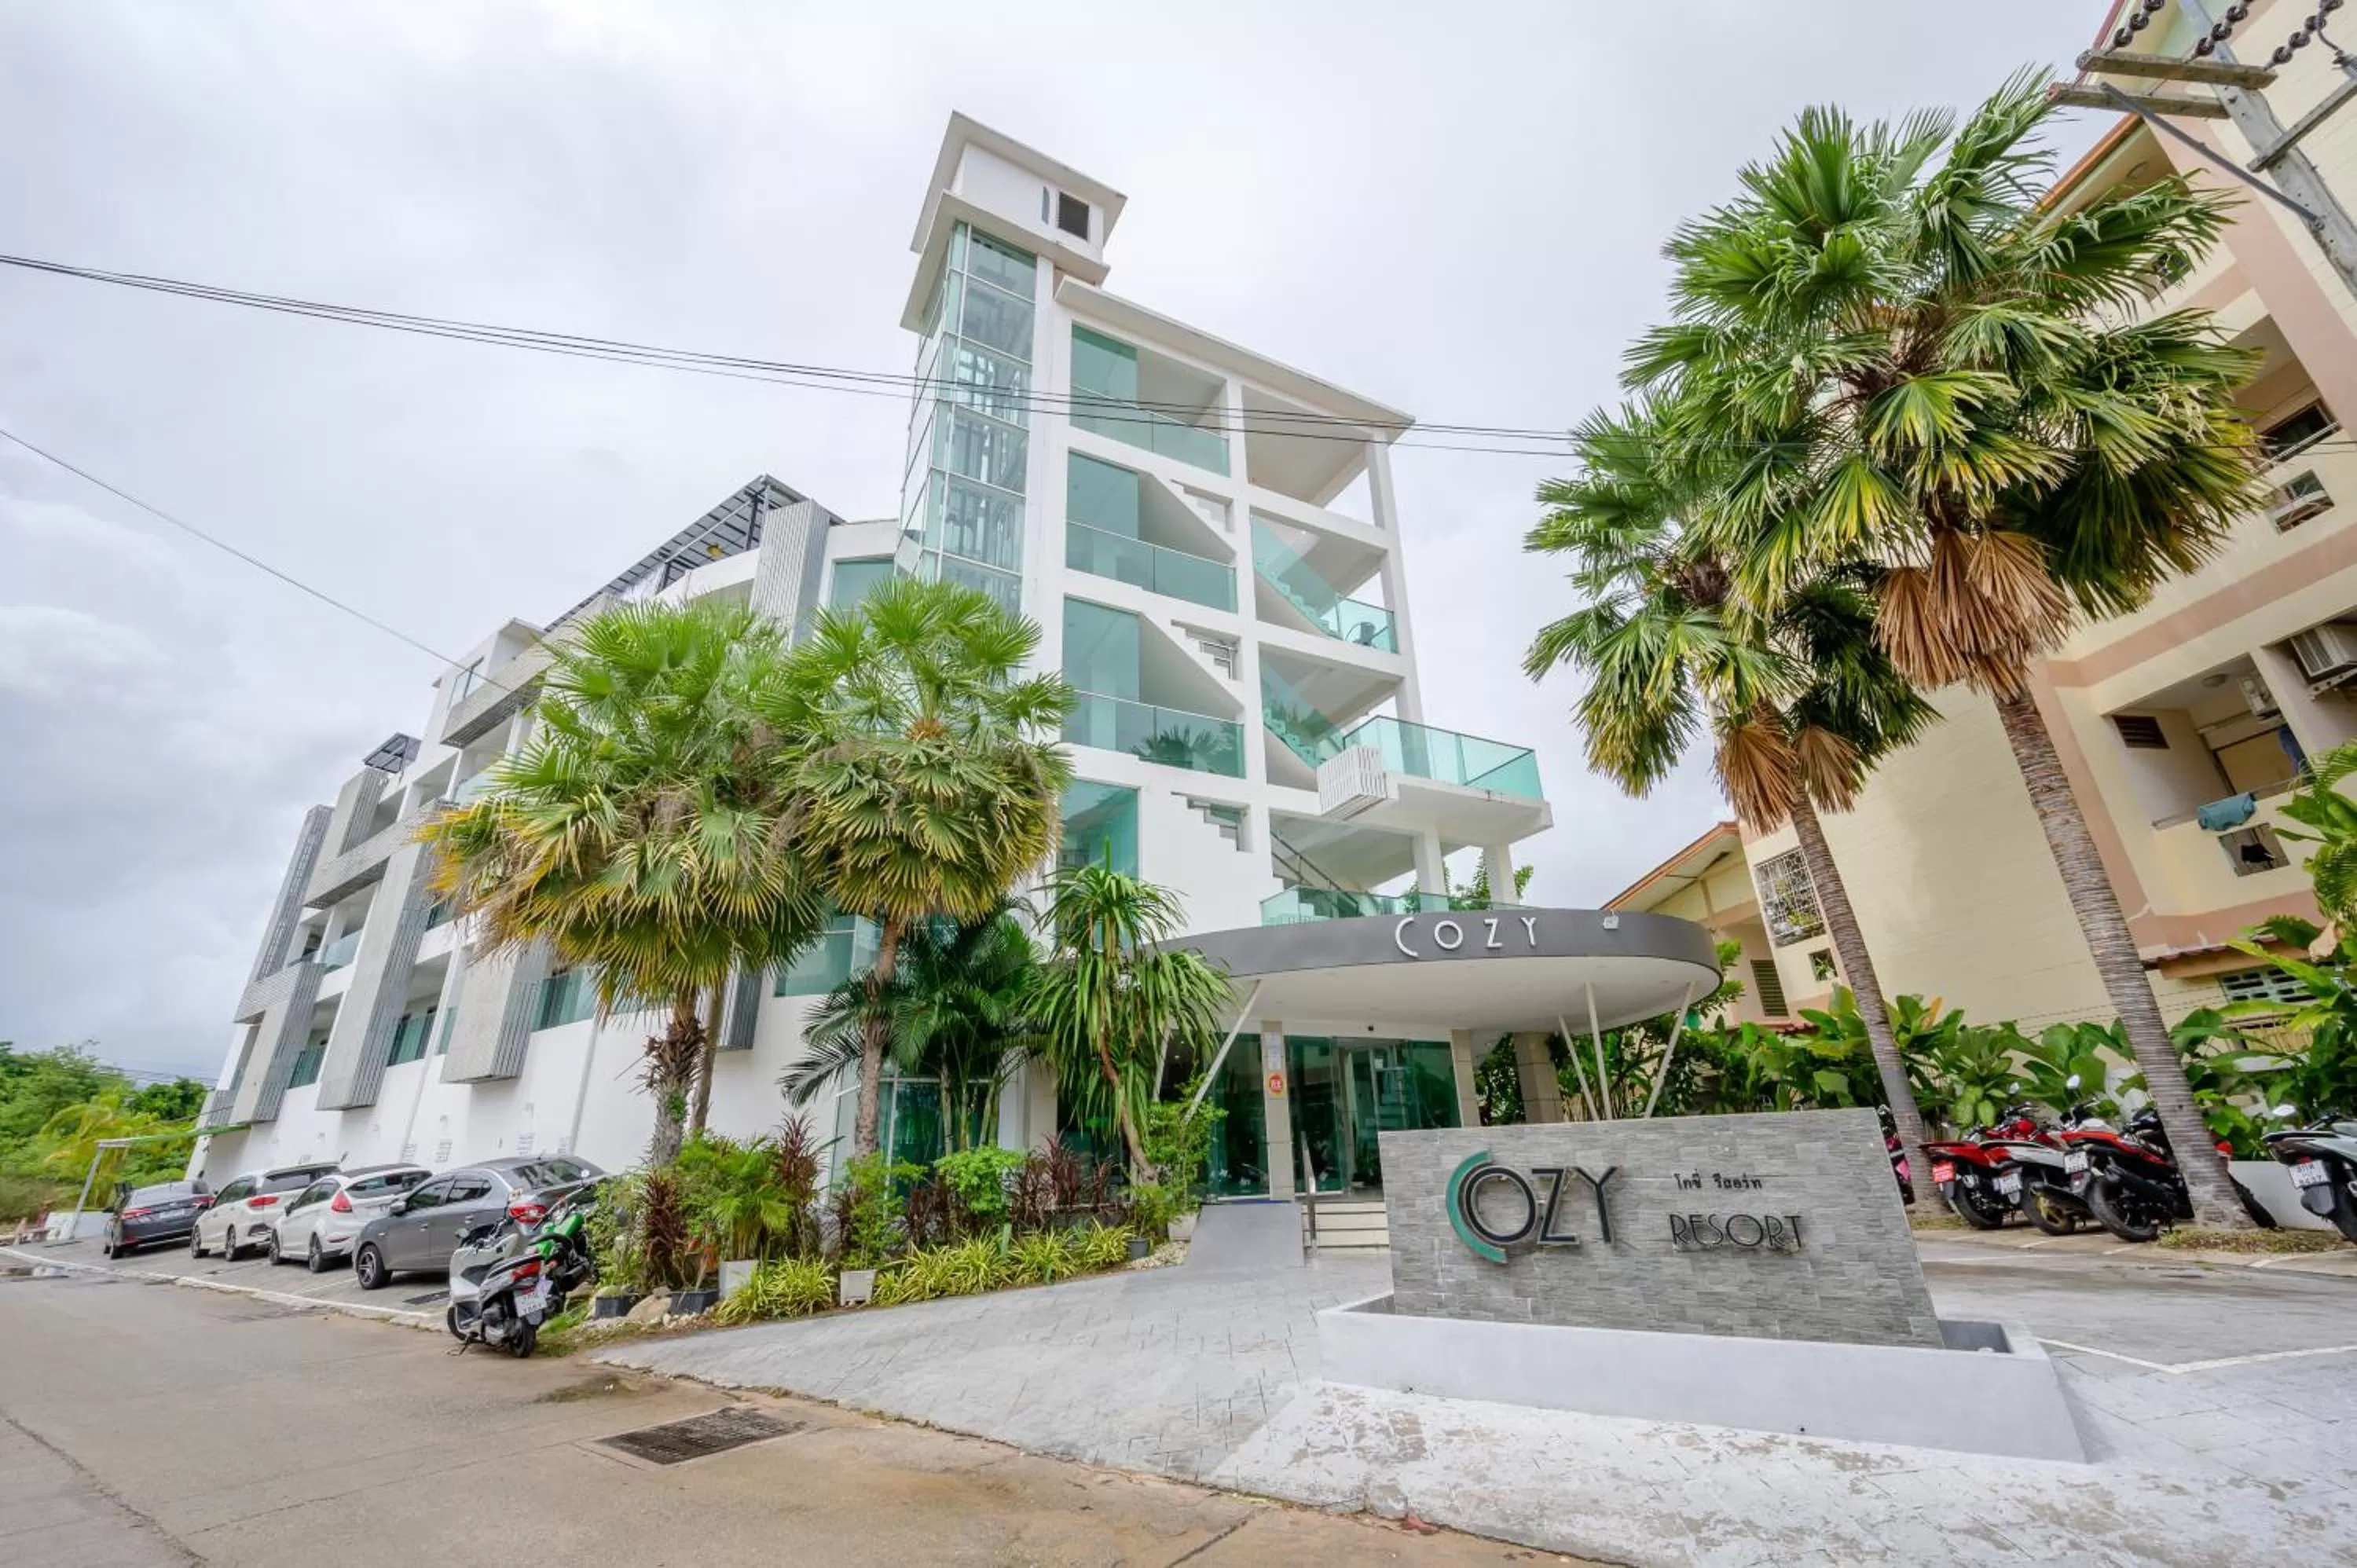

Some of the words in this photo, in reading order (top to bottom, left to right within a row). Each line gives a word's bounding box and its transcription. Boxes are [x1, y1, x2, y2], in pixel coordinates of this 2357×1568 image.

[1395, 917, 1537, 958] COZY
[1446, 1149, 1618, 1264] COZY
[1670, 1213, 1802, 1248] RESORT
